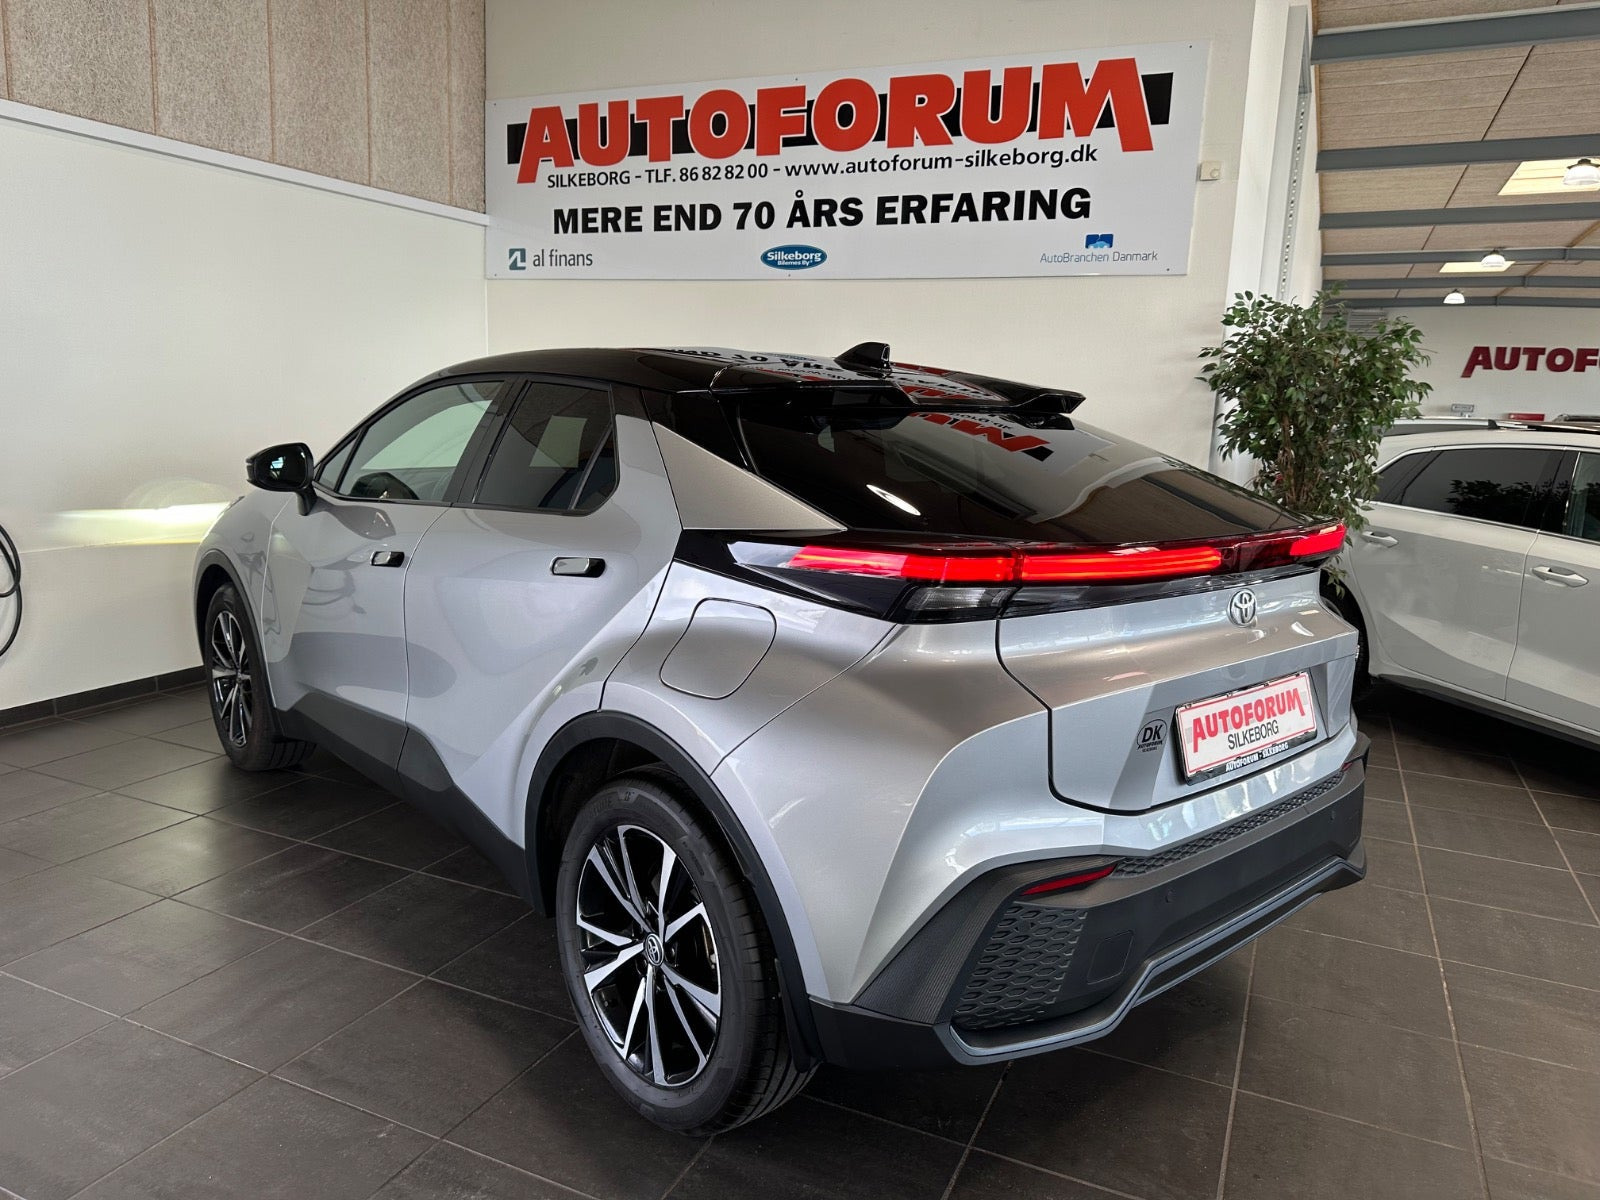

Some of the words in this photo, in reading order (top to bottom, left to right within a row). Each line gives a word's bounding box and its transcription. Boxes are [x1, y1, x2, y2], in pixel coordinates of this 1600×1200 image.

[516, 57, 1154, 184] AUTOFORUM
[547, 170, 631, 188] SILKEBORG
[645, 168, 676, 184] TLF.
[785, 144, 1098, 177] www.autoforum-silkeborg.dk
[553, 205, 643, 234] MERE
[653, 202, 722, 232] END
[733, 200, 776, 230] 70
[786, 189, 864, 228] ÅRS
[876, 187, 1092, 226] ERFARING
[533, 248, 545, 267] al
[549, 248, 593, 267] finans
[767, 250, 822, 262] Silkeborg
[1039, 252, 1110, 263] AutoBranchen
[1112, 250, 1159, 262] Danmark
[1460, 346, 1600, 378] AUTOF
[1142, 724, 1164, 743] DK
[1192, 687, 1306, 753] AUTOFORUM
[1227, 719, 1280, 750] SILKEBORG
